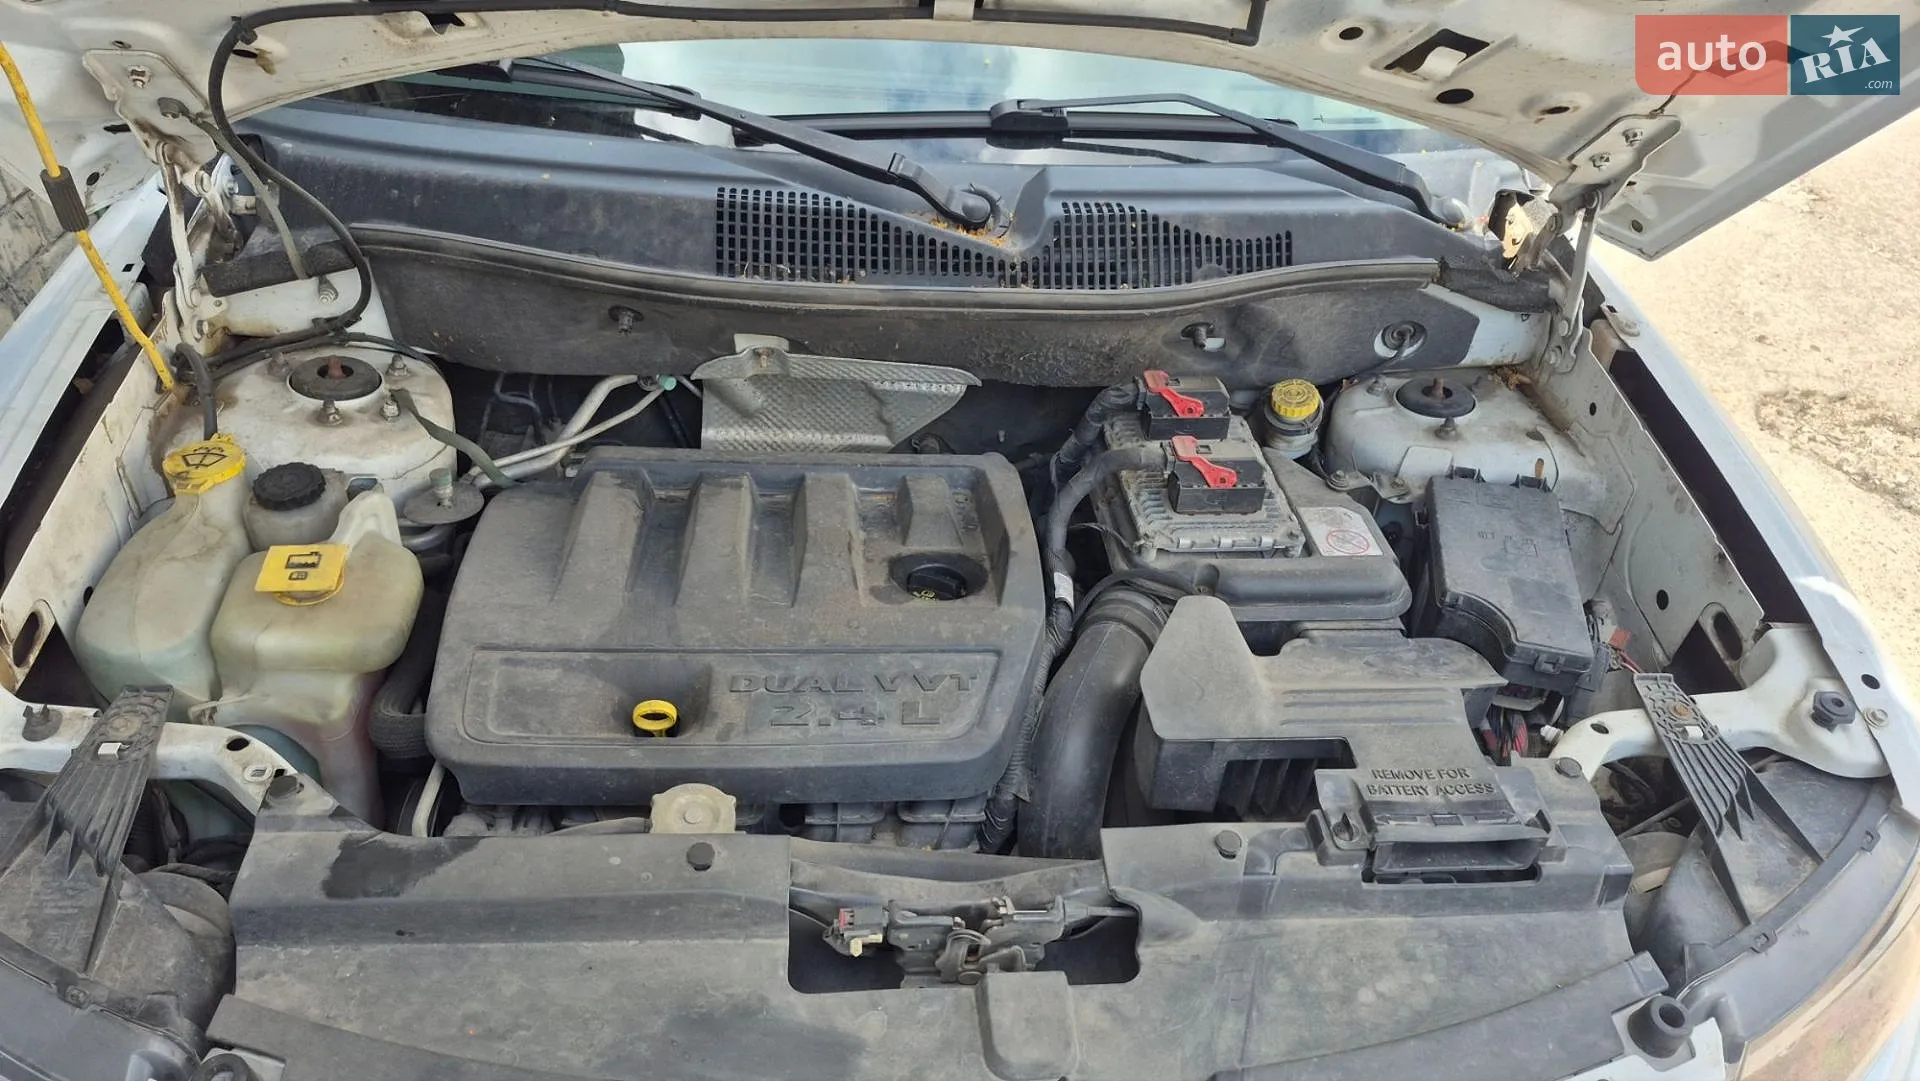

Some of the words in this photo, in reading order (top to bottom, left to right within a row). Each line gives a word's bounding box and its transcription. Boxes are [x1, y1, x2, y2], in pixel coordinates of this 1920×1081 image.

[729, 673, 864, 693] DUAL
[770, 700, 886, 727] 2.4
[901, 700, 940, 725] L
[1371, 768, 1437, 780] REMOVE
[1438, 767, 1471, 779] FOR
[1367, 784, 1430, 796] BATTERY
[1436, 783, 1495, 796] ACCESS
